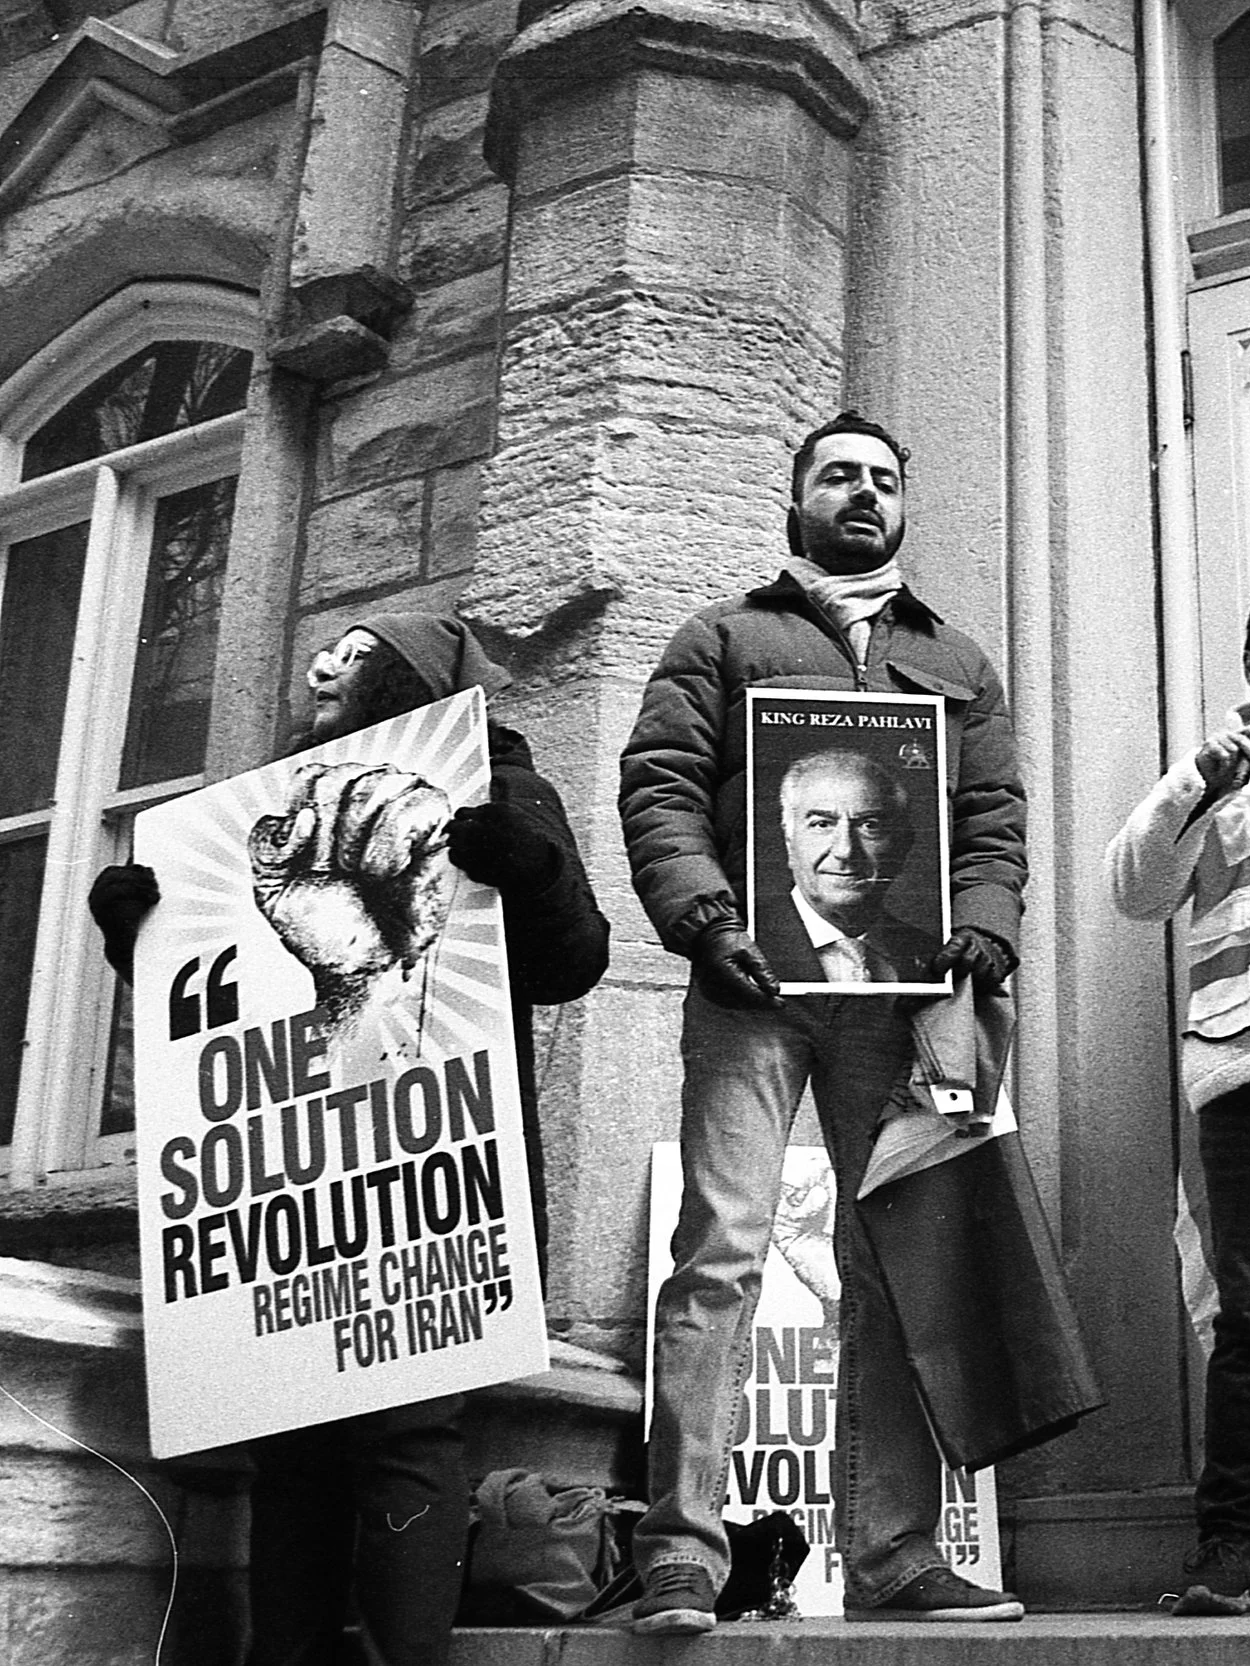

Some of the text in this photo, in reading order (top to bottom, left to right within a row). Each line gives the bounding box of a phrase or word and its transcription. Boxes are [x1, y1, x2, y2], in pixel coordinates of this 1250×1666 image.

[761, 712, 932, 729] KING REZA PAHLAVI
[199, 1008, 331, 1122] ONE
[160, 1050, 496, 1219] SOLUTION
[162, 1138, 504, 1303] REVOLUTION
[254, 1223, 511, 1337] REGIME CHANGE
[335, 1306, 399, 1372] FOR
[755, 1326, 836, 1384] NE
